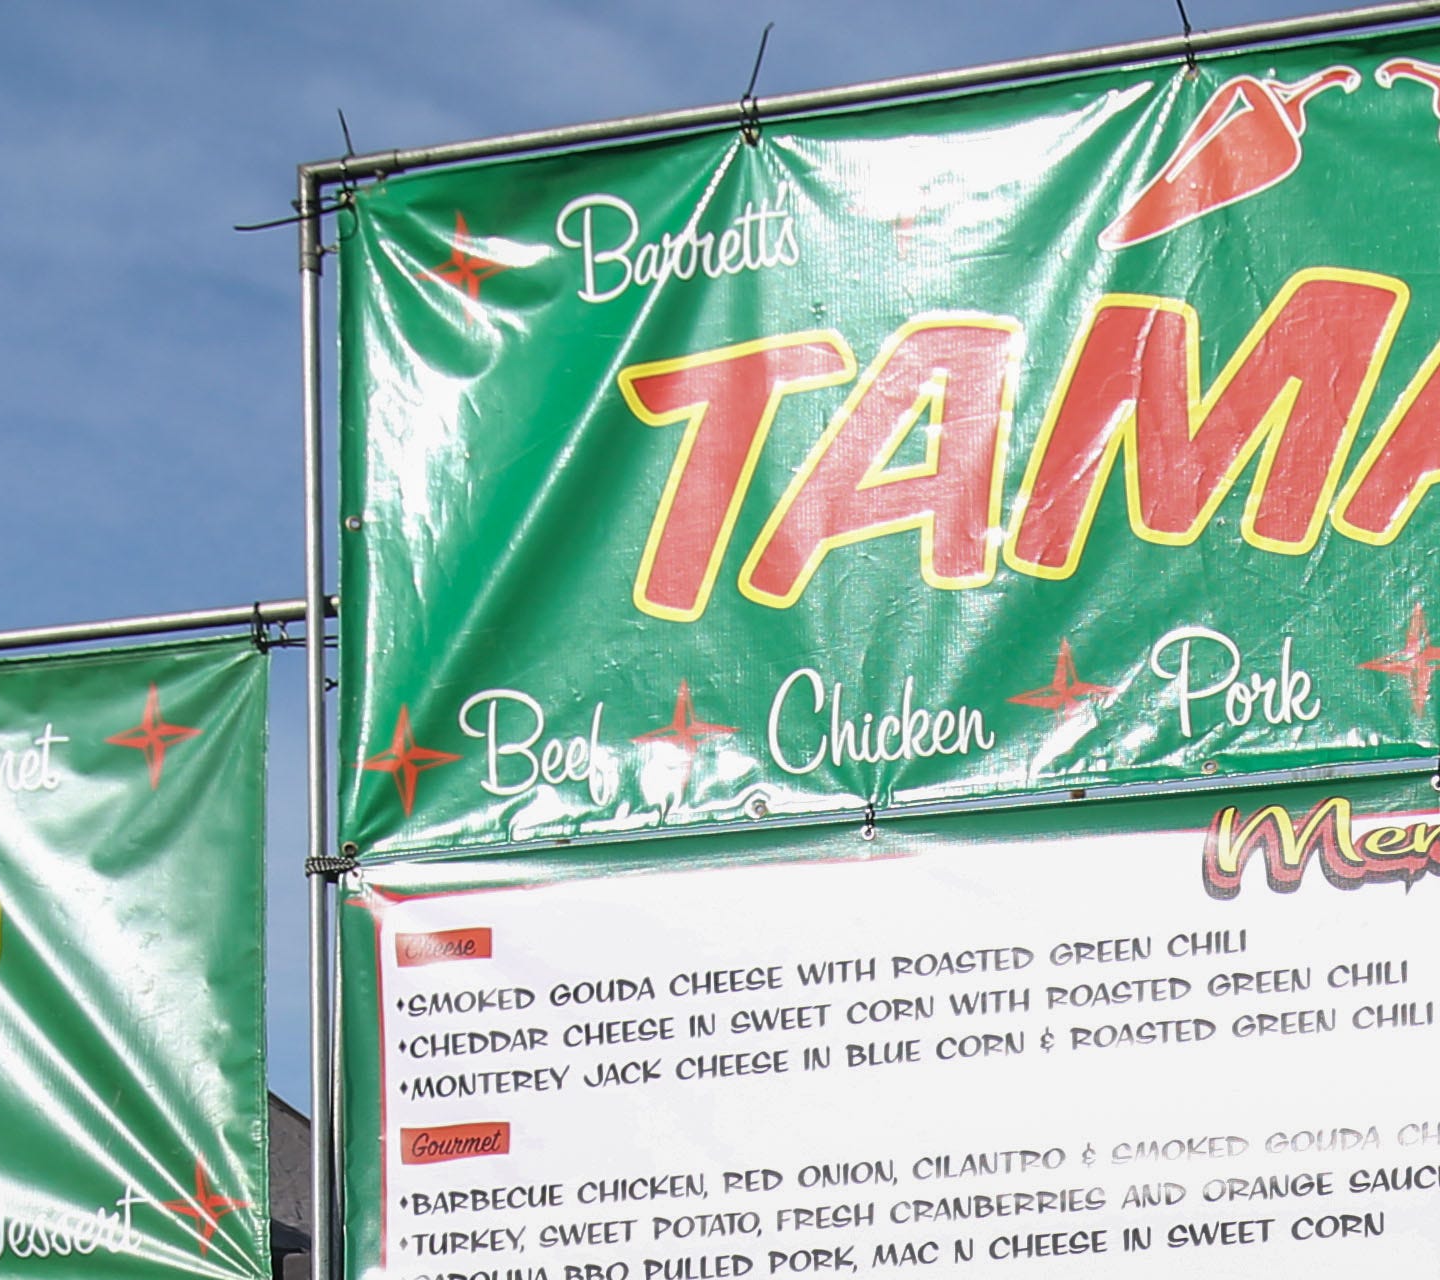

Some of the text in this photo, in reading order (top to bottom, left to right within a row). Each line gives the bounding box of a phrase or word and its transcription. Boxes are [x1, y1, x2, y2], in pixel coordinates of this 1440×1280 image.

[457, 687, 610, 805] Beef
[767, 668, 995, 777] Chicken
[1150, 625, 1323, 740] Pork
[404, 934, 476, 960] Cheese
[407, 927, 1247, 1018] SMOKED GOUDA CHEESE WITH ROASTED GREEN CHILI
[409, 958, 1409, 1060] CHEDDAR CHEESE IN SWEET CORN WITH ROASTED GREEN CHILI
[410, 1063, 571, 1102] MONTEREY
[582, 1056, 663, 1089] JACK
[674, 1047, 790, 1081] CHEESE
[802, 1043, 831, 1072] IN
[844, 1038, 922, 1069] BLUE
[935, 1029, 1025, 1061] CORN
[1068, 1016, 1217, 1051] ROASTED
[1231, 1006, 1337, 1039] GREEN
[1351, 999, 1434, 1030] CHILI
[410, 1130, 502, 1159] Gourmet
[410, 1223, 527, 1257] TURKEY,
[538, 1217, 639, 1249] SWEET
[651, 1210, 763, 1241] POTATO,
[776, 1200, 875, 1232] FRESH
[889, 1185, 1108, 1225] CRANBERRIES
[1120, 1180, 1188, 1210] AND
[1201, 1170, 1335, 1203] ORANGE
[767, 1243, 859, 1276] PORK,
[871, 1239, 940, 1270] MAC
[953, 1236, 974, 1264] N
[988, 1228, 1109, 1261] CHEESE
[1122, 1224, 1152, 1253] IN
[1166, 1217, 1277, 1249] SWEET
[1290, 1209, 1385, 1241] CORN
